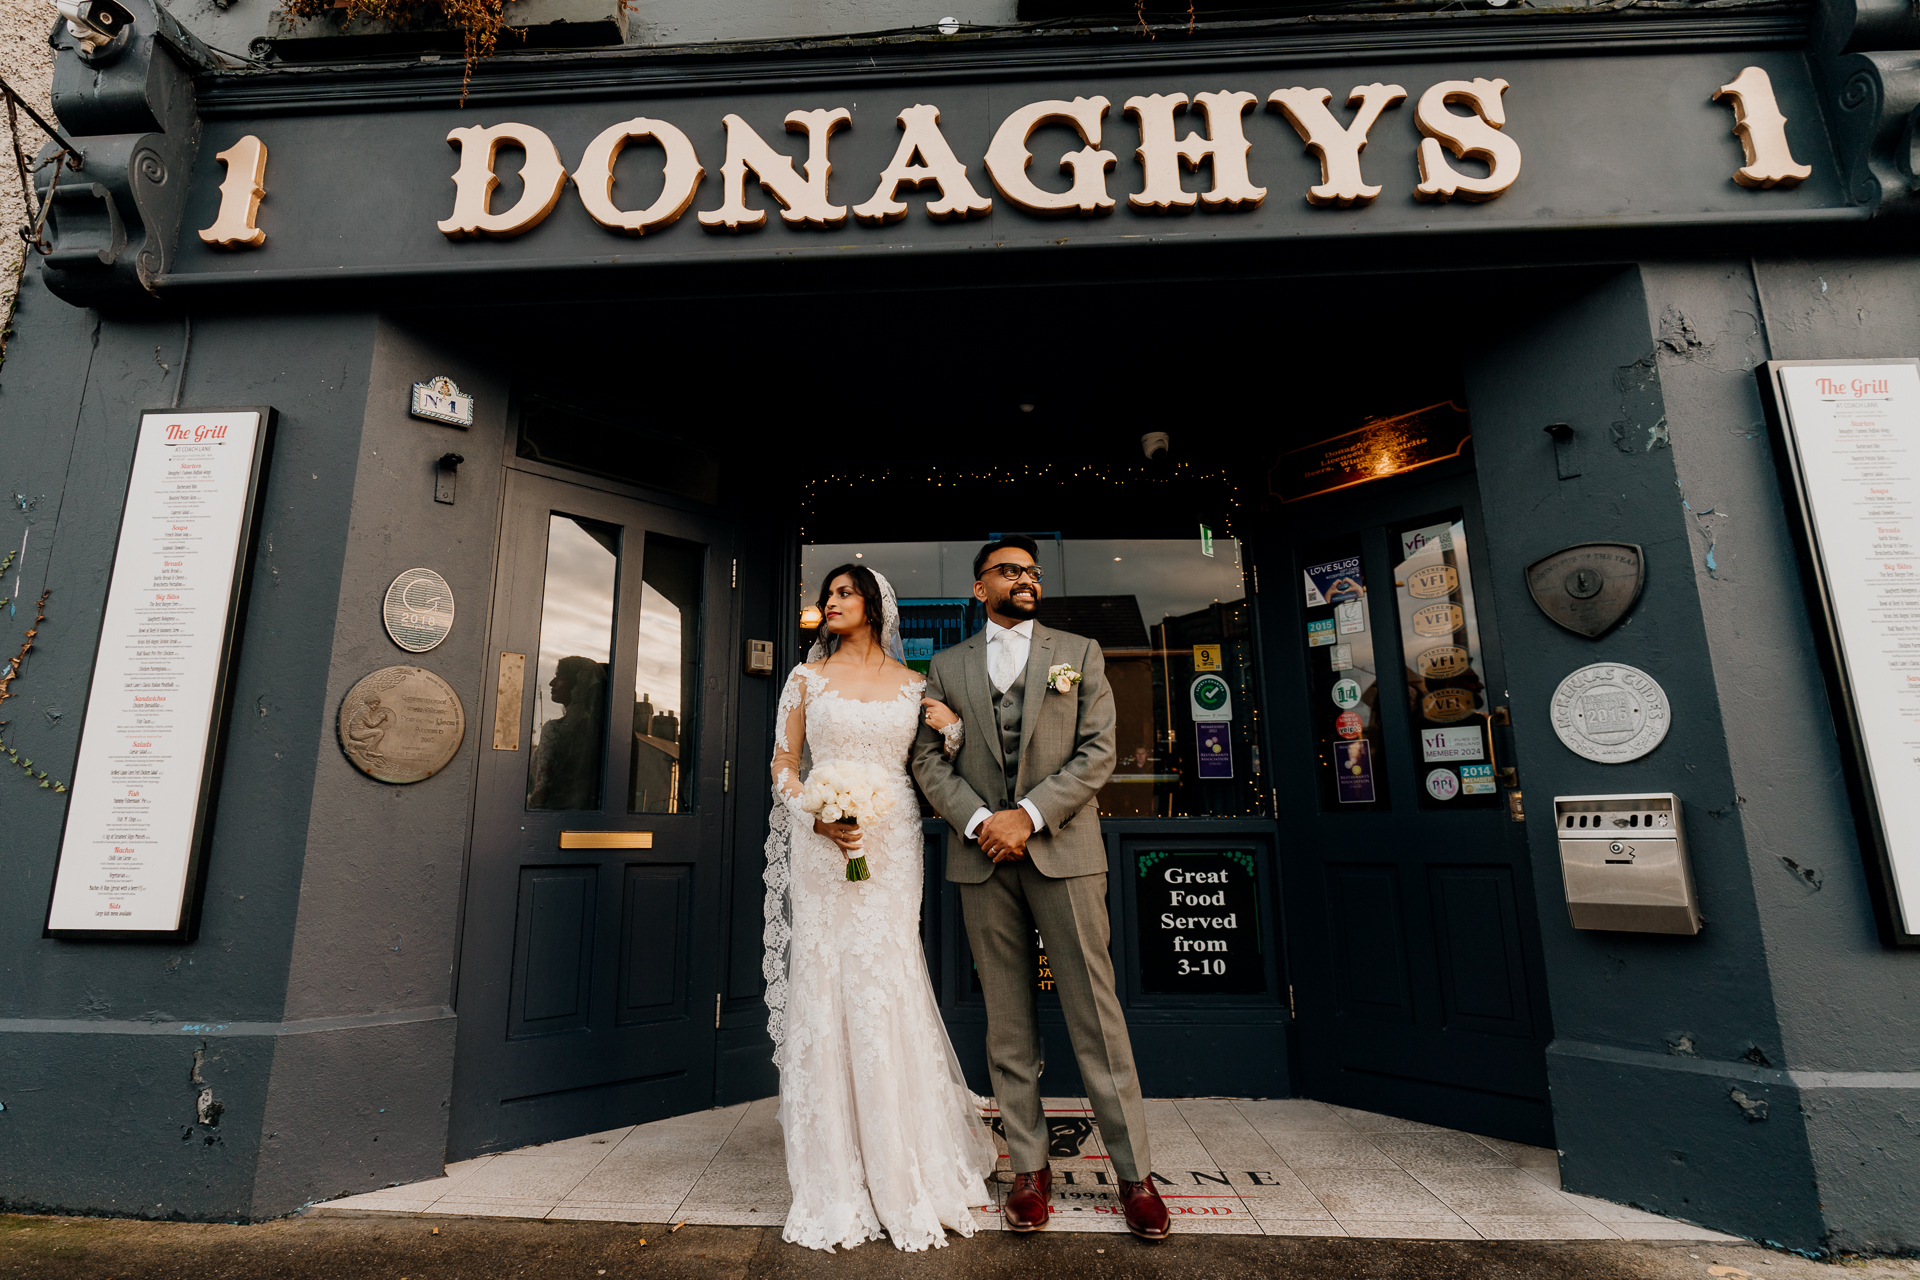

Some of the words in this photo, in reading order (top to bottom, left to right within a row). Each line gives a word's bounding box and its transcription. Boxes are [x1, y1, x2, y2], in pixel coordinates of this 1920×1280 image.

[198, 134, 266, 249] 1
[436, 77, 1522, 242] DONAGHYS
[1713, 65, 1812, 190] 1
[1816, 378, 1846, 394] The
[1851, 378, 1889, 398] Grill
[166, 424, 191, 440] The
[194, 425, 228, 442] Grill
[1320, 448, 1364, 466] Licensed
[1405, 533, 1426, 550] vfi
[1310, 564, 1332, 576] LOVE
[1333, 558, 1359, 571] SLIGO
[1614, 555, 1638, 566] YEAR
[1420, 574, 1444, 587] VFI
[401, 612, 436, 626] 2018
[1425, 612, 1449, 625] VFI
[1310, 621, 1332, 632] 2015
[1201, 650, 1210, 662] 9
[1430, 656, 1454, 667] VFI
[1622, 673, 1664, 719] GUIDES
[1435, 698, 1460, 710] VFI
[1587, 707, 1628, 723] 2016
[1339, 726, 1354, 735] yelp
[1425, 733, 1446, 748] vfi
[1463, 766, 1491, 776] 2014
[1432, 779, 1452, 790] PPI
[1164, 868, 1229, 884] Great
[1169, 890, 1226, 906] Food
[1161, 913, 1238, 929] Served
[1172, 936, 1228, 952] from
[1178, 959, 1226, 975] 3-10
[1094, 1205, 1232, 1215] SEOOD
